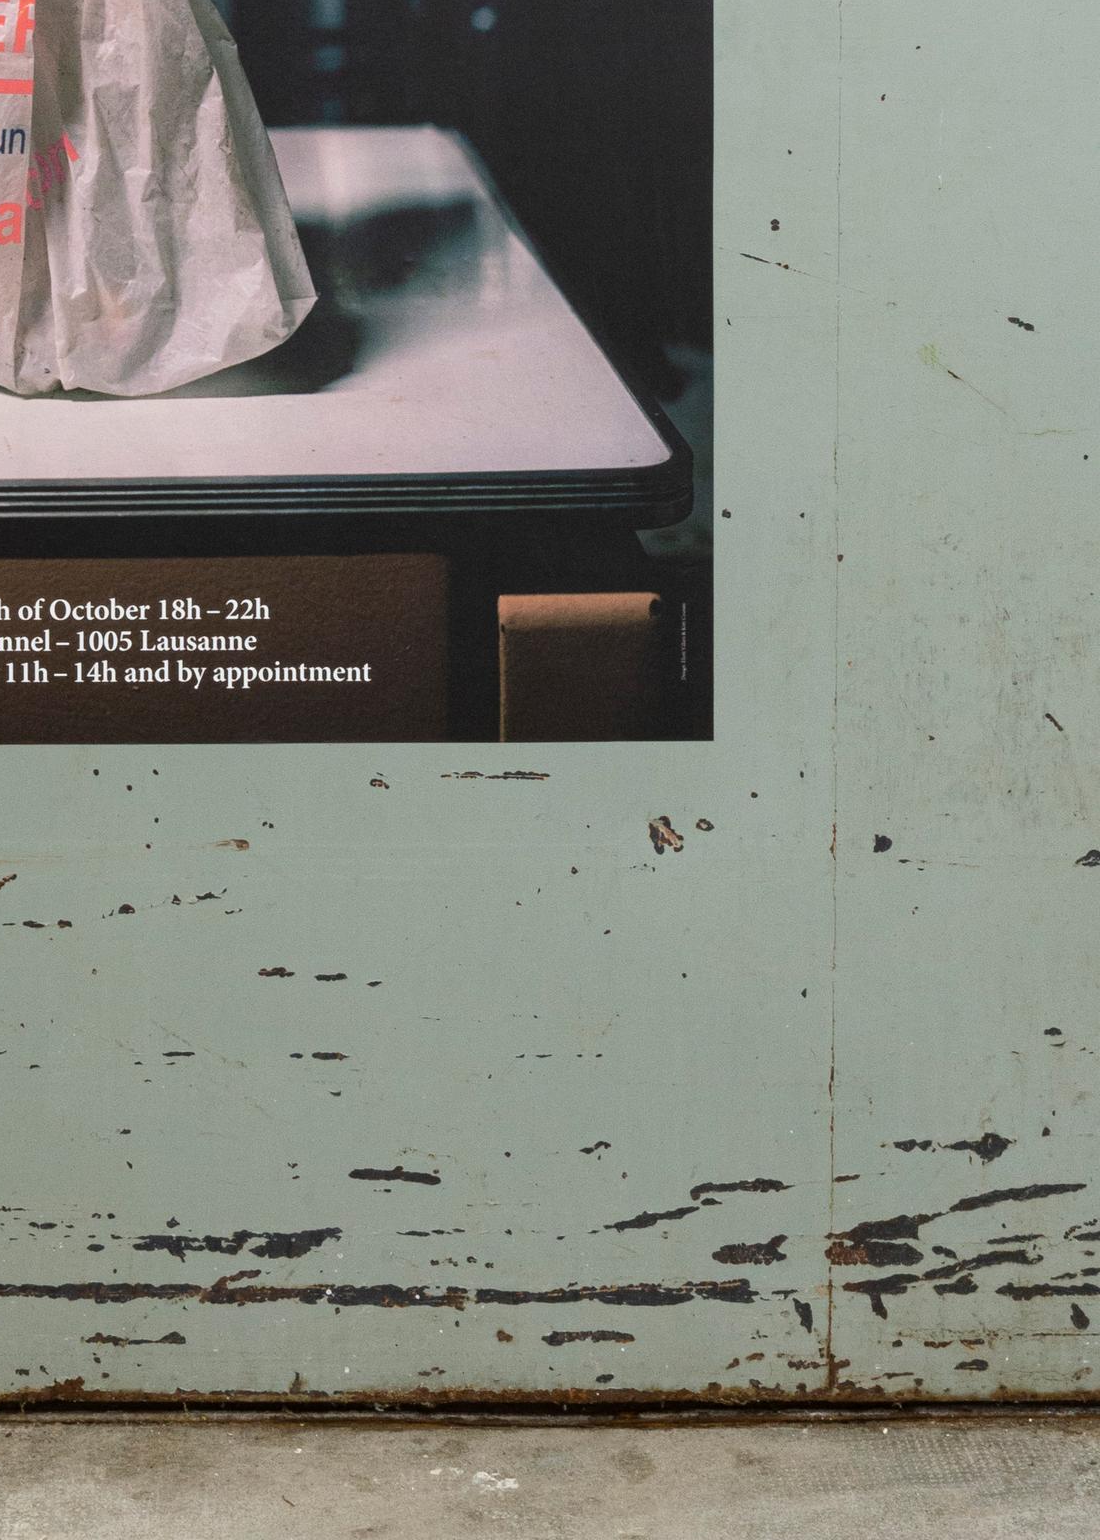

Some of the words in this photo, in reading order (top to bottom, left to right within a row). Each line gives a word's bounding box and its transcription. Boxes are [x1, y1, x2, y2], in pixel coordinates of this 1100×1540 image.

[18, 597, 42, 621] of
[49, 597, 150, 621] October
[76, 630, 133, 653] 1005
[140, 630, 258, 652] Lausanne
[124, 659, 170, 683] and
[177, 659, 207, 690] by
[213, 660, 372, 689] appointment
